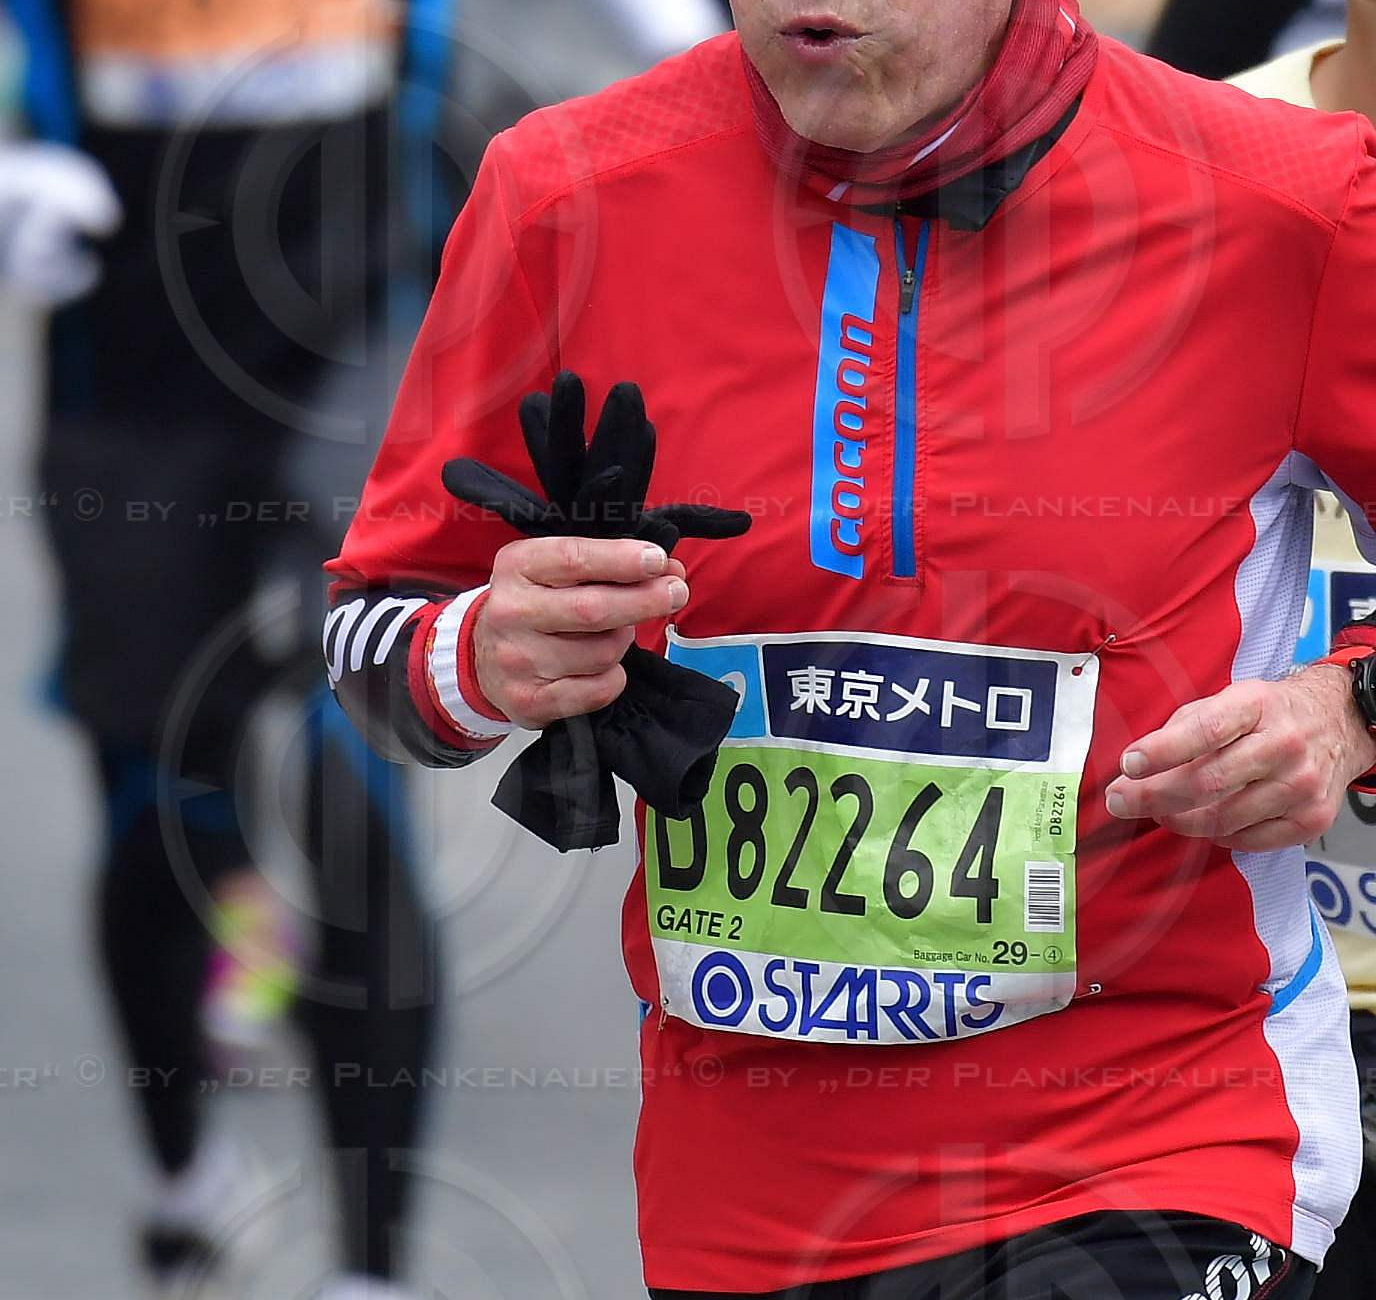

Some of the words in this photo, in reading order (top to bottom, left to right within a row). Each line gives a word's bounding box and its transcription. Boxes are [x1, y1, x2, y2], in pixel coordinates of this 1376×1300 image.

[831, 312, 874, 557] cocoon
[786, 665, 1033, 732] 東京メトロ
[1049, 786, 1067, 836] D82264
[655, 763, 1005, 925] D82264
[656, 904, 724, 940] GATE
[728, 915, 743, 941] 2
[913, 949, 953, 962] Baggage
[956, 951, 972, 962] Car
[975, 952, 990, 964] No.
